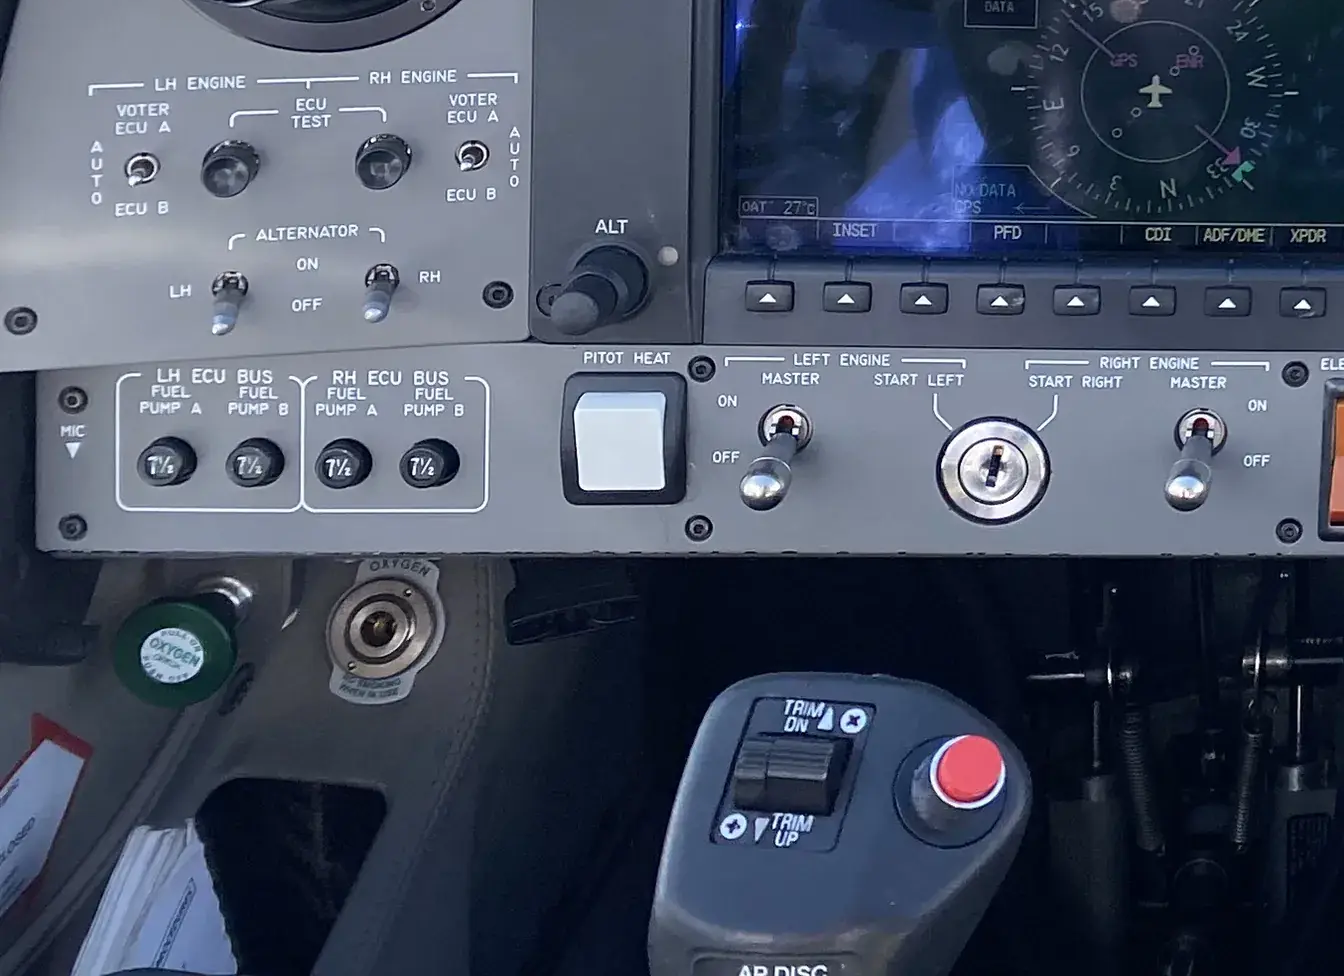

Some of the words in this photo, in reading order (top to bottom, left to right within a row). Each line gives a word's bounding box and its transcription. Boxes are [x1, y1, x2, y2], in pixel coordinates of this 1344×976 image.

[154, 77, 177, 92] LH
[187, 75, 246, 91] ENGINE
[369, 71, 392, 85] RH
[401, 69, 457, 84] ENGINE
[255, 224, 359, 242] ALTERNATOR
[832, 222, 880, 238] INSET
[994, 224, 1022, 240] PFD
[1203, 227, 1266, 243] ADF/DME
[583, 351, 625, 365] PITOT
[633, 351, 672, 365] HEAT
[793, 352, 831, 366] LEFT
[839, 353, 891, 367] ENGINE
[1099, 356, 1142, 370] RIGHT
[1149, 356, 1200, 370] ENGINE
[157, 368, 181, 383] LH
[191, 368, 226, 384] ECU
[237, 368, 273, 385] BUS
[784, 699, 826, 718] TRIM
[774, 829, 799, 847] UP
